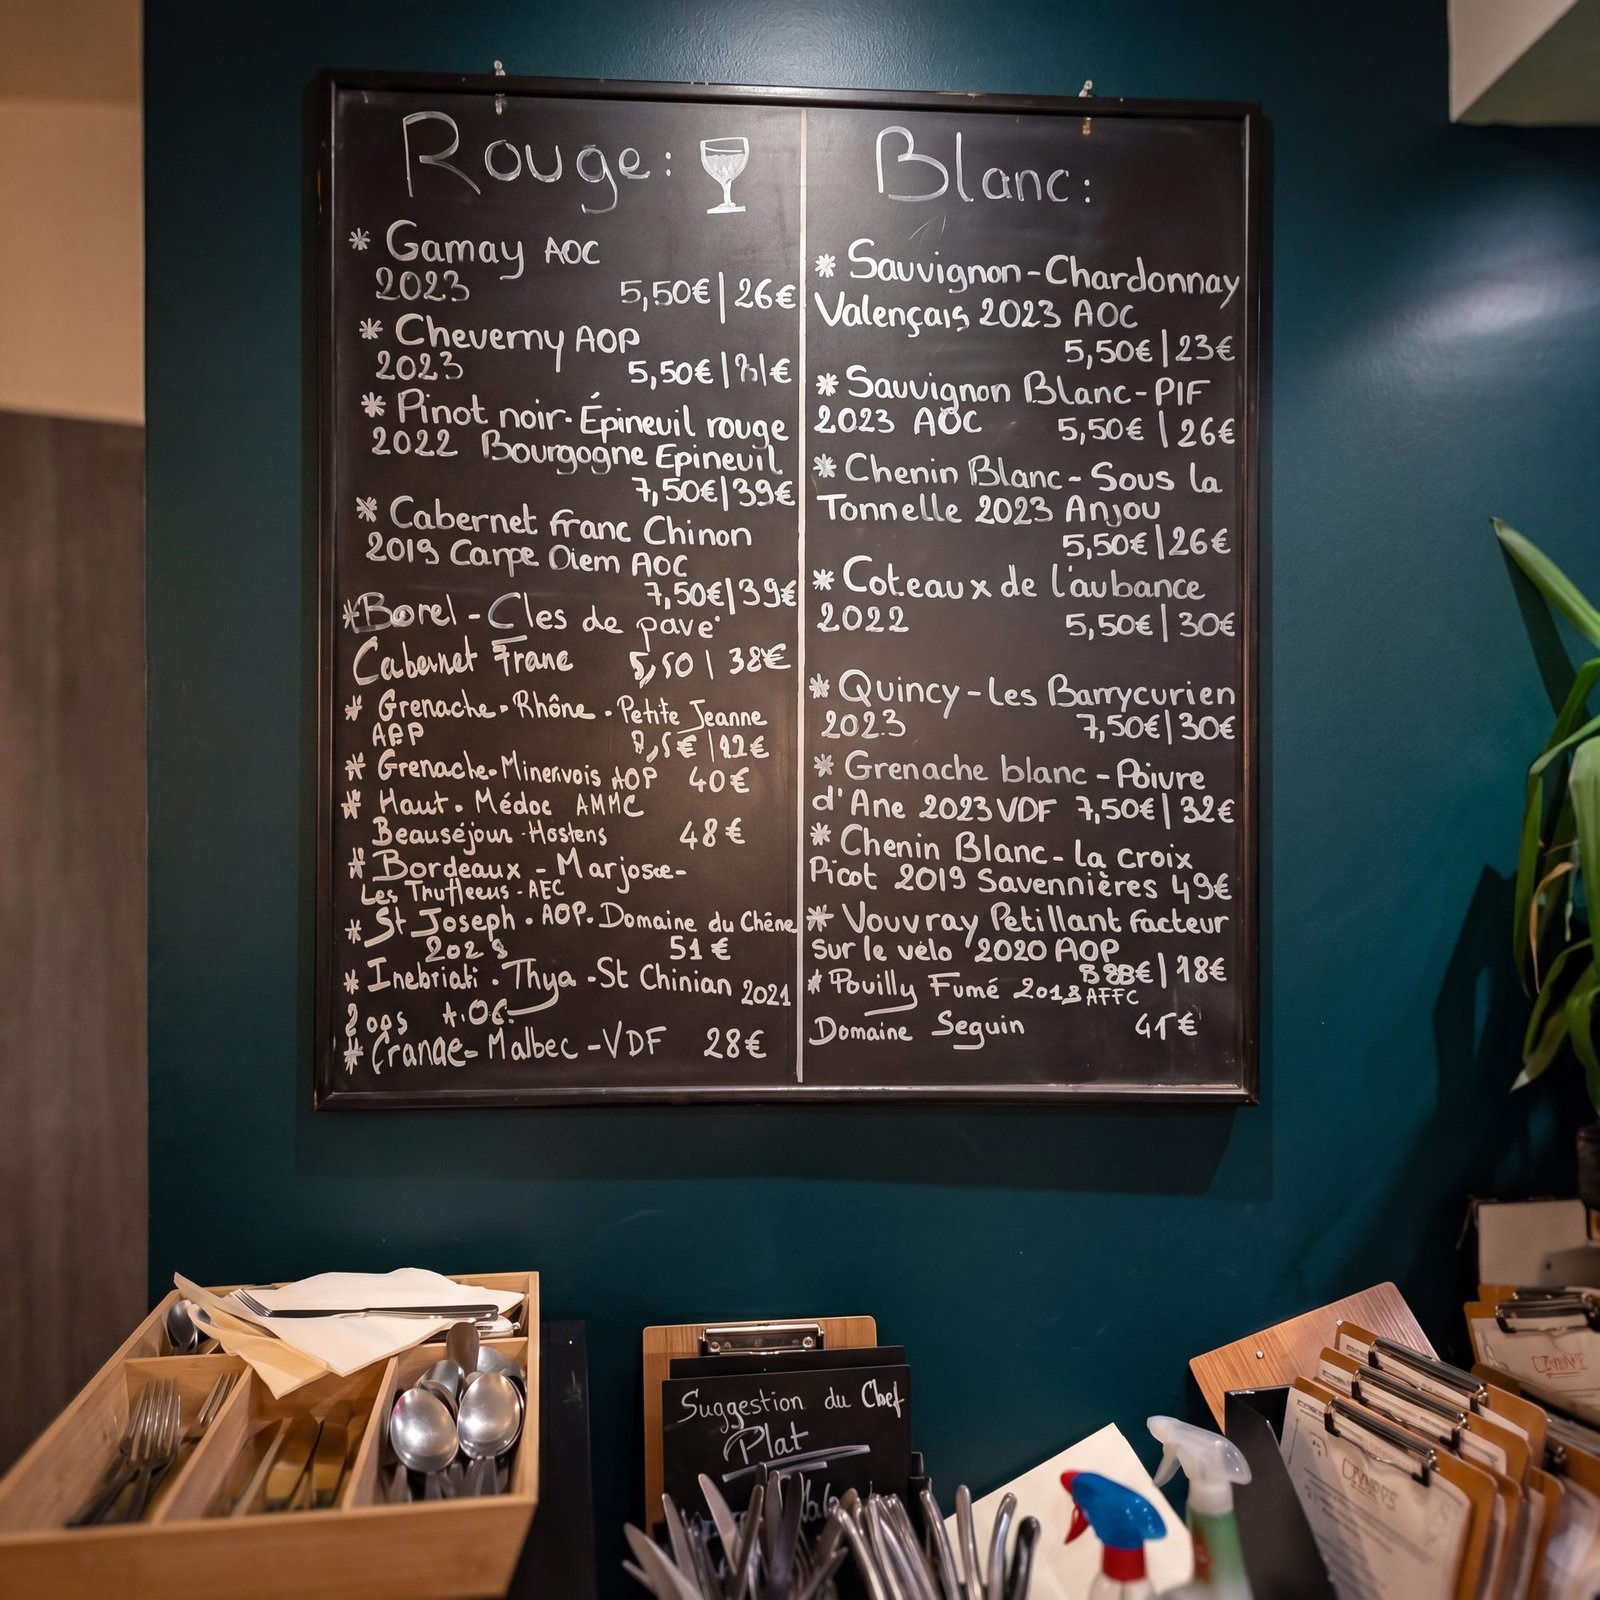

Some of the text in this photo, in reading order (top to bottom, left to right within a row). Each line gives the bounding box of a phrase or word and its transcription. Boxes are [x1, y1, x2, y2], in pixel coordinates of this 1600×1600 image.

[386, 220, 601, 280] Gamay AOC
[376, 267, 471, 302] 2023
[815, 291, 1138, 337] Valençais 2023 AOC
[576, 325, 640, 354] AOP
[376, 350, 464, 381] 2023
[847, 365, 1011, 411] Sauvignon
[398, 389, 488, 425] Pinot
[707, 416, 789, 449] rouge
[814, 406, 895, 435] 2023
[914, 408, 983, 437] AOC
[372, 427, 784, 477] 2022 Bourgogne Epineuil
[845, 452, 959, 485] Chenin
[968, 455, 1063, 490] Blanc
[1091, 461, 1175, 493] Sous
[390, 495, 539, 535] Cabernet
[644, 515, 753, 547] Chinon
[817, 493, 1161, 528] Tonnelle 2023 Anjou
[450, 539, 540, 577] Carpe
[632, 552, 688, 578] AOC
[842, 555, 992, 600] Coteaux
[1001, 564, 1037, 598] de
[583, 606, 624, 633] de
[818, 603, 909, 633] 2022
[353, 636, 479, 685] Cabernet
[379, 690, 496, 722] Grenache
[617, 695, 680, 725] Petite
[677, 699, 768, 734] Jeanne
[838, 669, 960, 719] Quincy
[844, 750, 1206, 790] Grenache blanc Poivre
[919, 794, 993, 822] 2023
[997, 797, 1057, 823] VDF
[371, 816, 513, 855] Beauséjour
[840, 824, 940, 860] Chenin
[955, 831, 1048, 865] Blanc
[1117, 844, 1193, 869] croix
[372, 849, 521, 882] Bordeaux
[809, 856, 878, 890] Picot
[894, 863, 967, 892] 2019
[977, 867, 1158, 899] Savennières
[361, 884, 399, 905] Les
[364, 906, 407, 949] St
[410, 904, 516, 942] Joseph
[599, 902, 698, 933] Domaine
[708, 911, 735, 933] du
[740, 910, 798, 933] Chêne
[842, 901, 979, 949] Vouvray
[990, 902, 1122, 933] Petillant
[811, 938, 856, 960] sur
[864, 935, 888, 961] le
[974, 937, 1047, 963] 2020
[1055, 937, 1120, 963] AOP
[640, 963, 732, 997] Chinian
[741, 979, 791, 1007] 2021
[928, 971, 1001, 1000] Fumé
[488, 1027, 579, 1060] Malbec
[603, 1021, 668, 1059] VDF
[704, 1028, 767, 1059] 28€
[809, 1016, 914, 1046] Domaine
[932, 1011, 1025, 1050] Seguin
[677, 1379, 905, 1433] Suggestion du Chef
[723, 1421, 809, 1464] Plat
